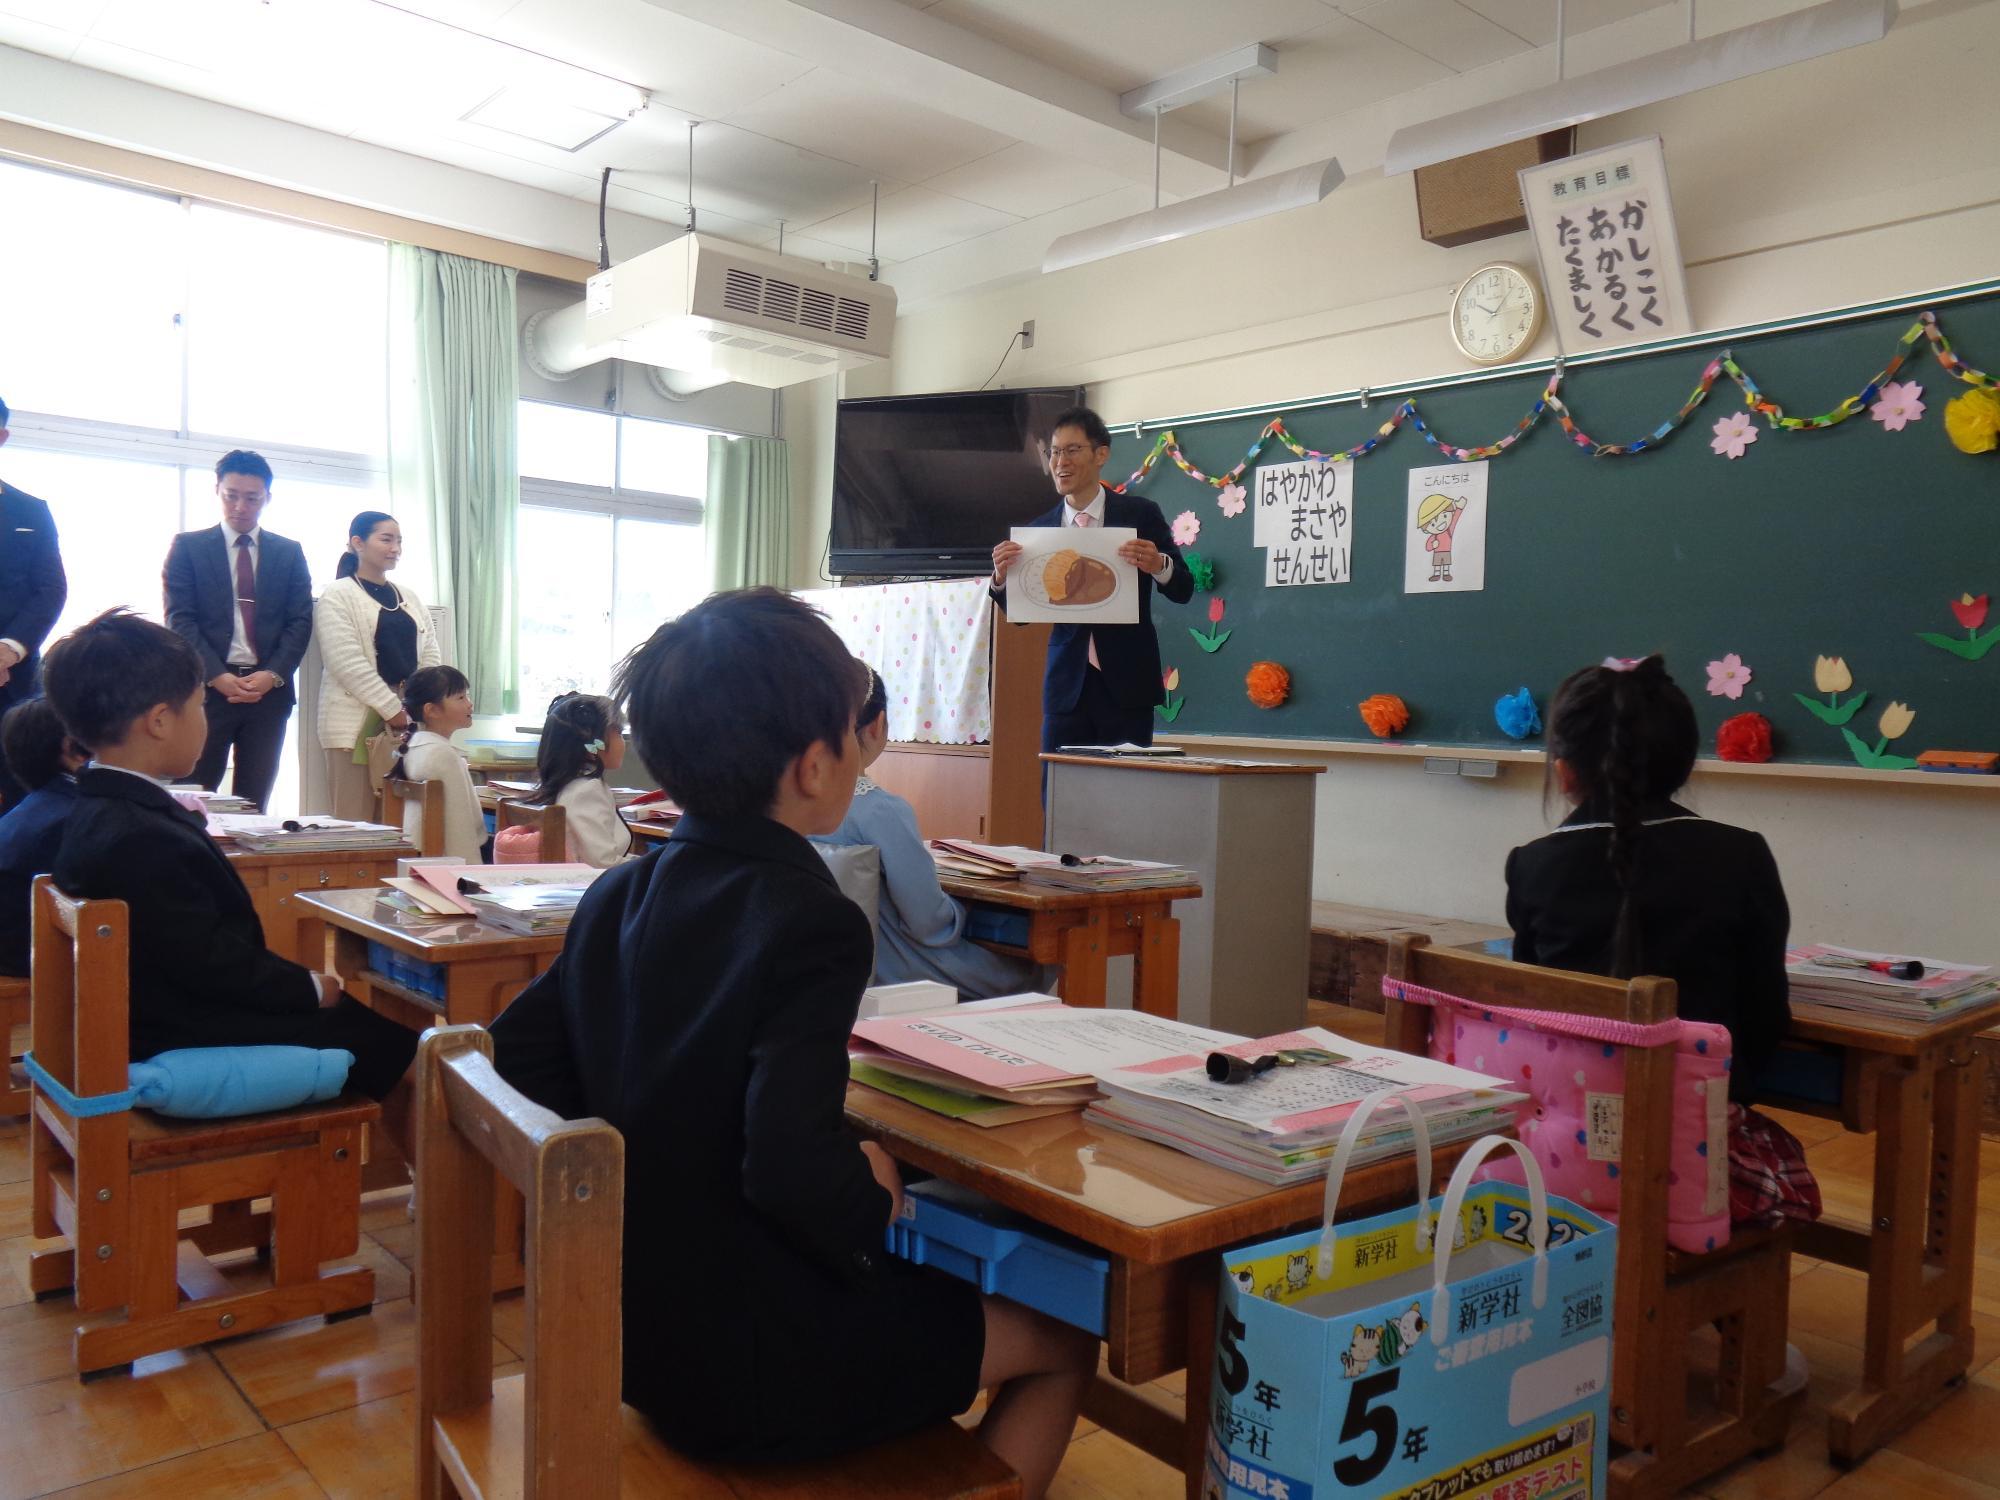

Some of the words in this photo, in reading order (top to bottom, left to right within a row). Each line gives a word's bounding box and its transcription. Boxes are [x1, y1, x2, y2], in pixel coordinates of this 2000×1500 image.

[1553, 165, 1631, 197] 教育目標
[1556, 216, 1602, 338] たくましく
[1587, 206, 1634, 331] あかるく
[1619, 200, 1663, 326] かしこく
[1476, 284, 1485, 296] 11
[1489, 275, 1500, 288] 12
[1507, 278, 1513, 289] 1
[1518, 287, 1528, 299] 2
[1462, 314, 1469, 326] 9
[1522, 302, 1530, 315] 3
[1480, 338, 1488, 351] 7
[1493, 341, 1501, 352] 6
[1260, 463, 1336, 507] はやかわ
[1423, 472, 1470, 487] こんにちは
[1290, 501, 1347, 541] まさや
[1273, 545, 1348, 584] せんせい
[1354, 1239, 1398, 1268] 新学社
[1457, 1284, 1521, 1334] 新学社
[1333, 1367, 1429, 1487] 5年
